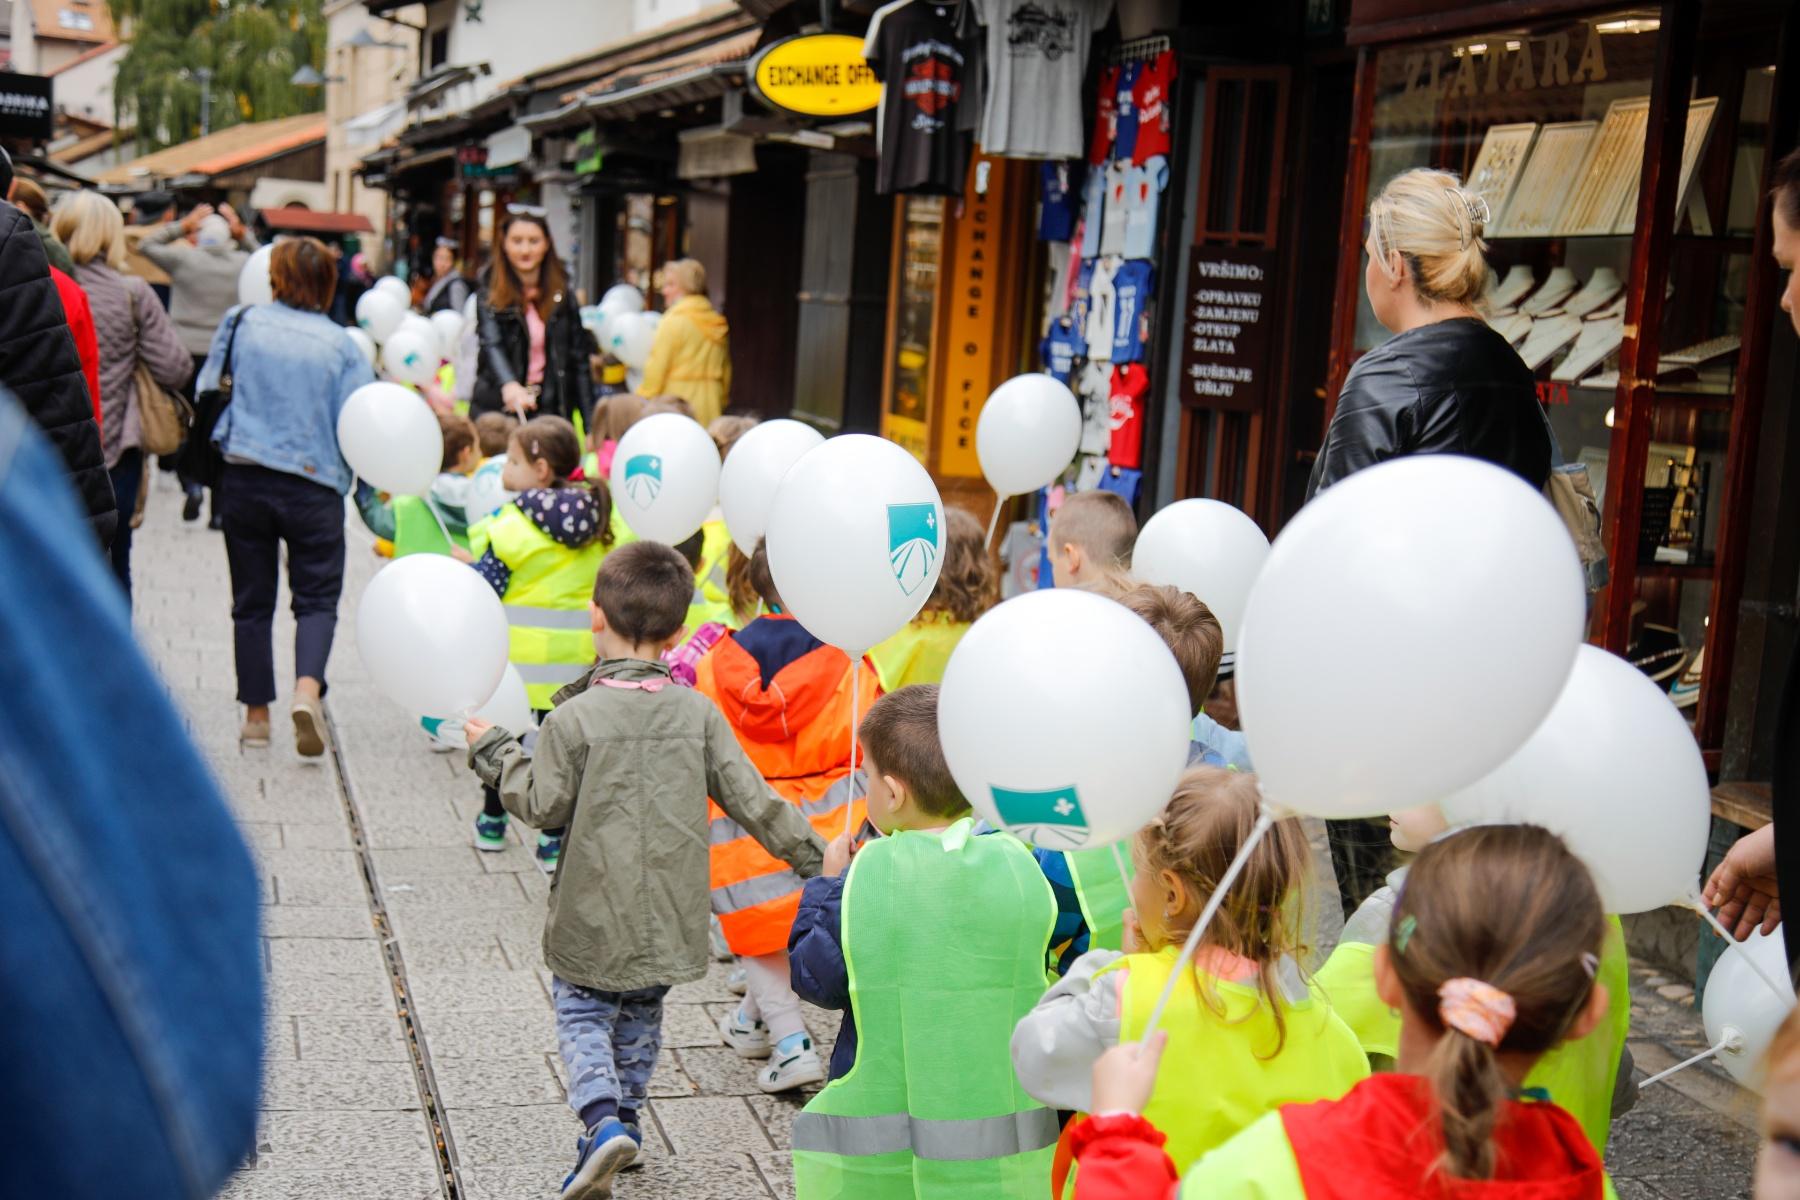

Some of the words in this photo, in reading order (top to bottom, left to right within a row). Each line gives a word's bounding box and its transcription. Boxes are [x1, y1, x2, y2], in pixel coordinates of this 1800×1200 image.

[1404, 21, 1607, 97] ZLATARA
[768, 65, 840, 86] EXCHANGE
[847, 64, 877, 84] OFF
[967, 190, 987, 318] XCHANGE
[1198, 260, 1263, 281] VRŠIMO:
[1193, 337, 1236, 355] ZLATA
